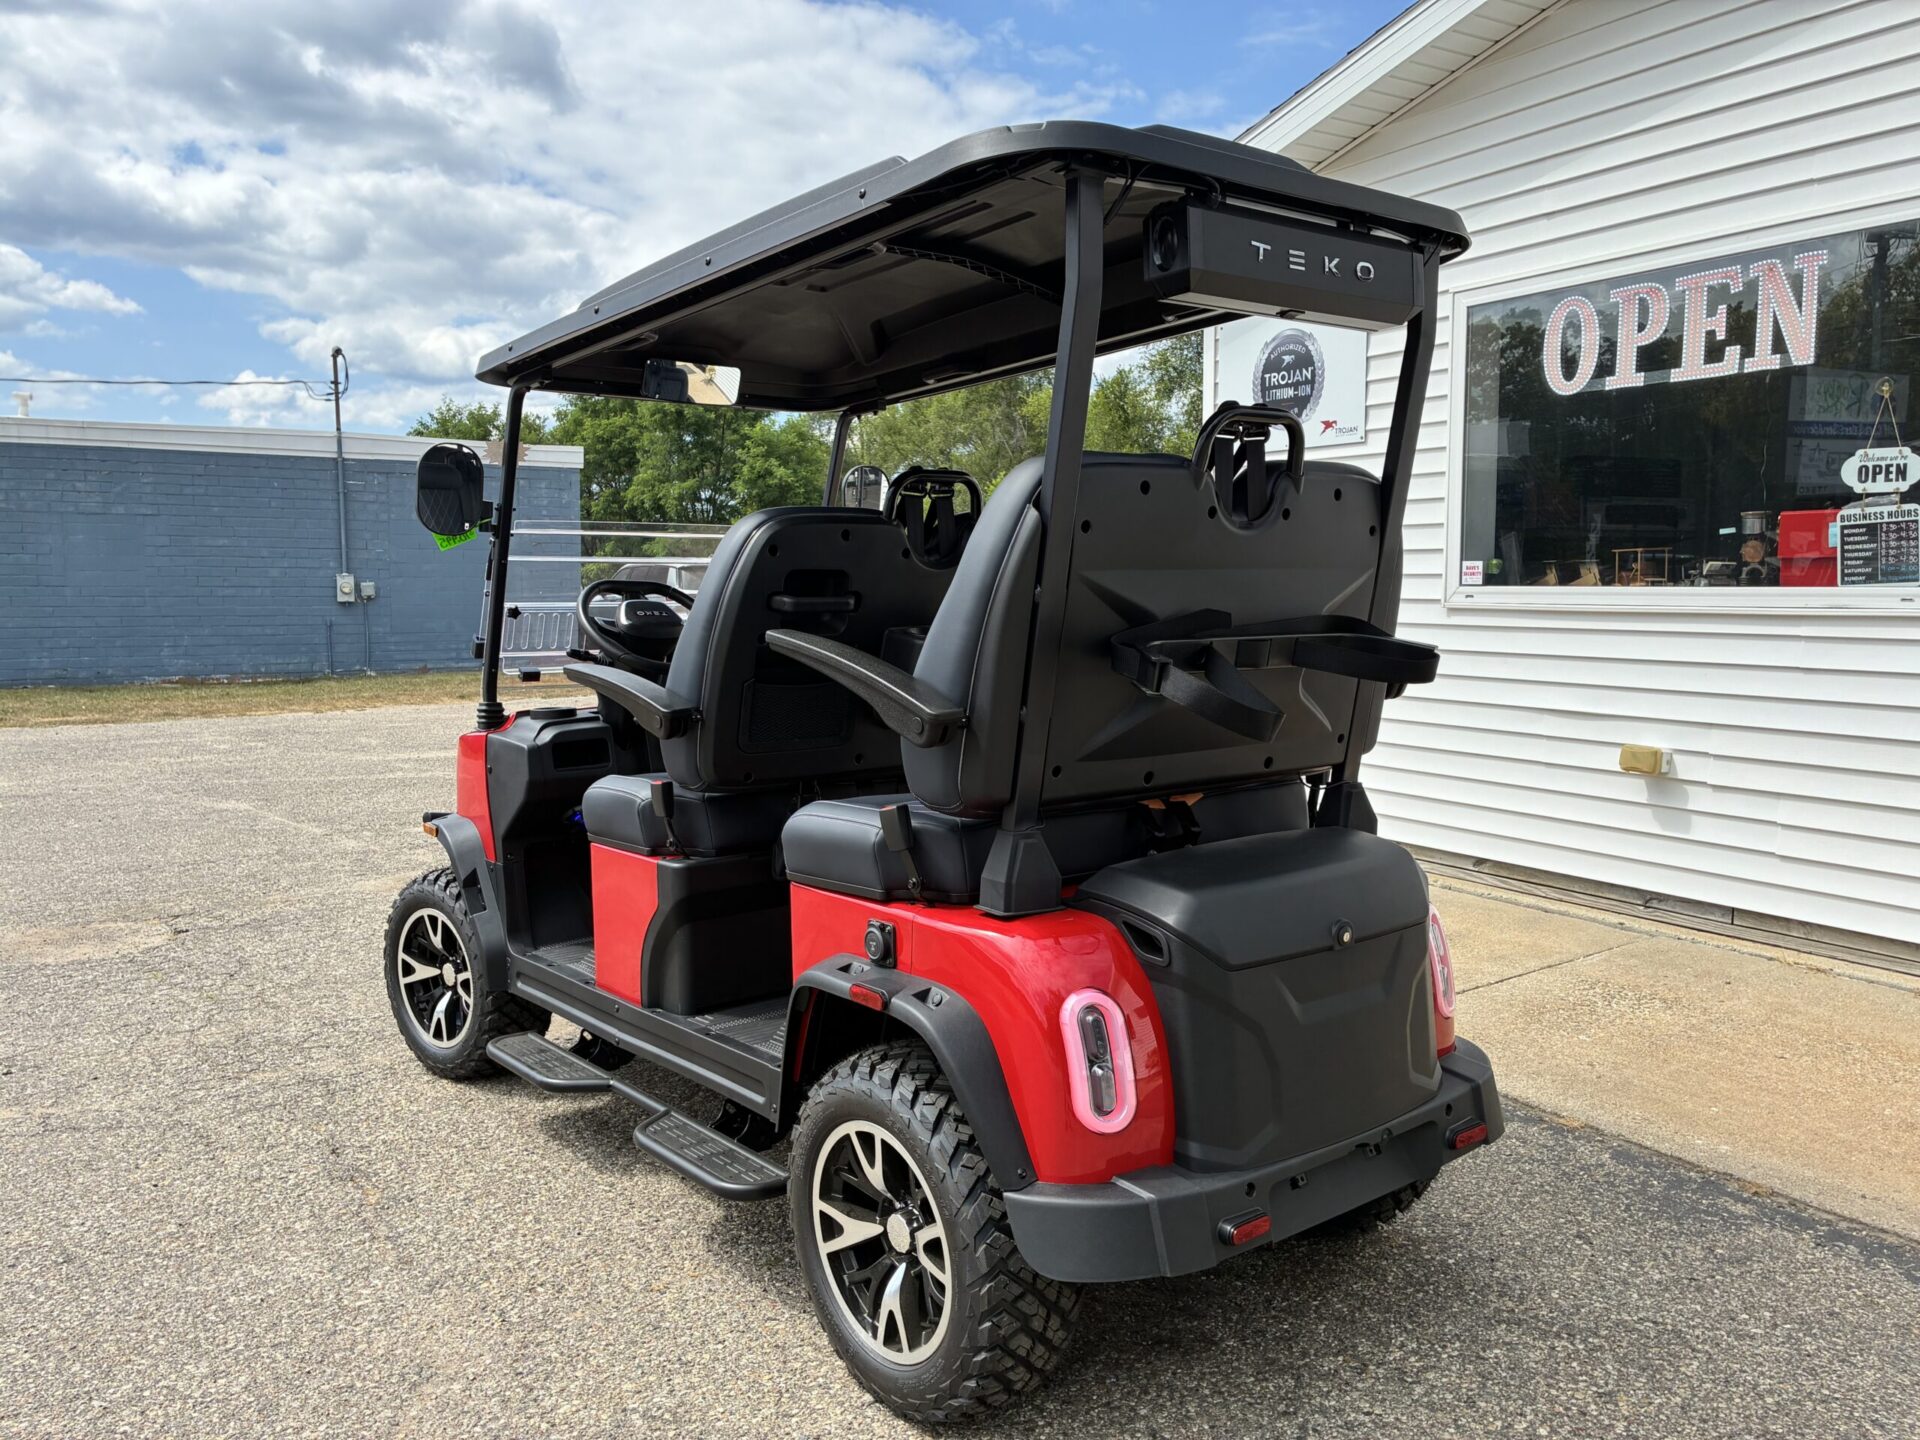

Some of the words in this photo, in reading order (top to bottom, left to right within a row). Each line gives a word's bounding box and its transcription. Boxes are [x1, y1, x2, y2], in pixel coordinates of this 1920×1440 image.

[1251, 240, 1375, 282] TEKO
[1543, 249, 1829, 395] OPEN
[1270, 343, 1307, 361] AUTHORIZED
[1264, 367, 1312, 387] TROJAN
[1265, 384, 1312, 402] LITHIUM-ION
[1335, 425, 1359, 435] TROJAN
[1859, 453, 1888, 463] Welcome
[1857, 462, 1908, 484] OPEN
[1840, 511, 1885, 523] BUSINESS
[1887, 508, 1919, 520] HOURS
